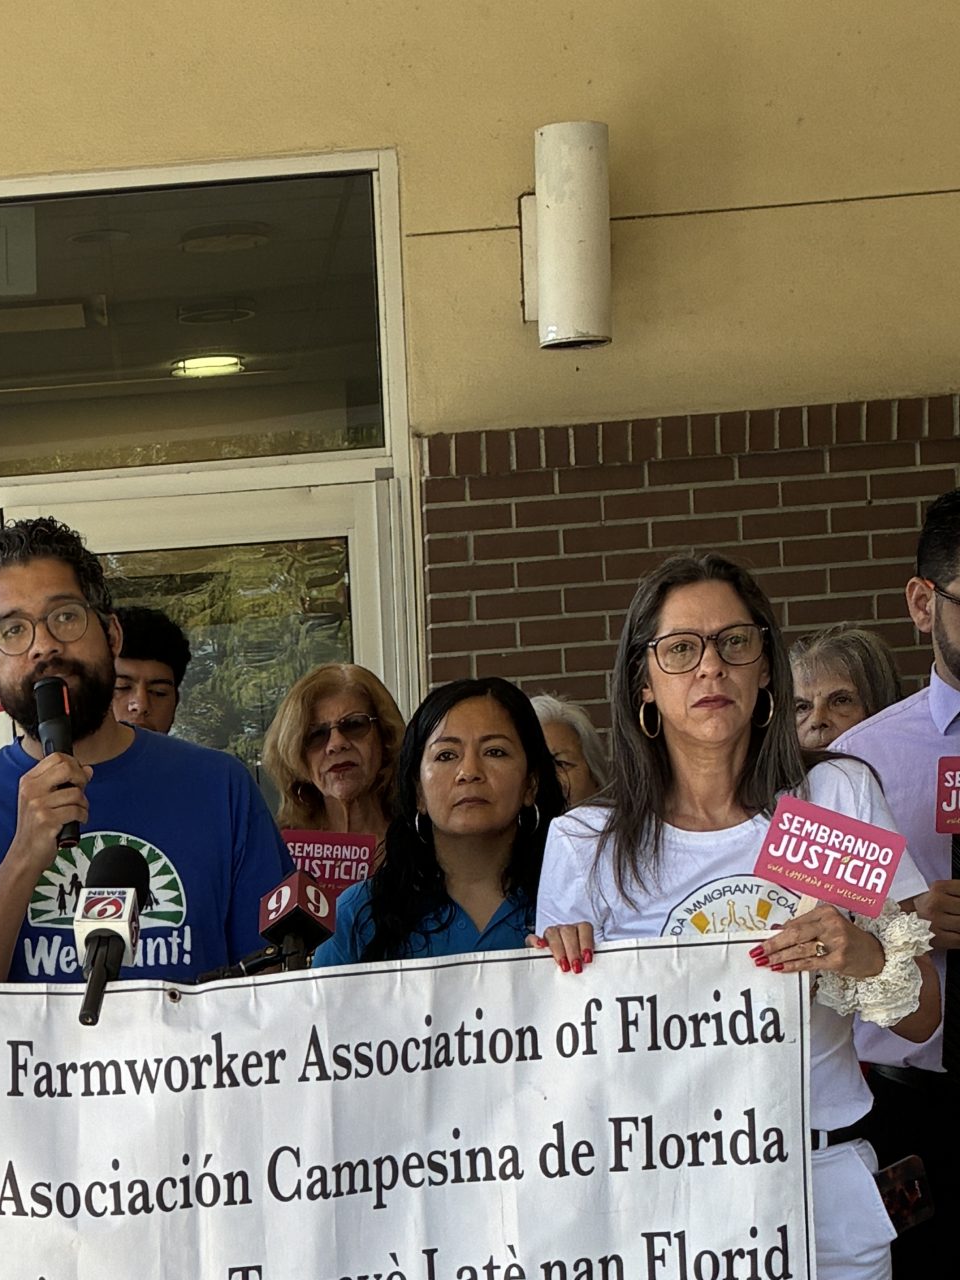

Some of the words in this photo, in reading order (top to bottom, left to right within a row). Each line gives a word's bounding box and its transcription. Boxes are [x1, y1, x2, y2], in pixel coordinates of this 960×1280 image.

[287, 842, 370, 860] SEMBRANDO
[779, 812, 894, 866] SEMBRANDO
[85, 897, 125, 919] 6
[87, 889, 128, 897] NEWS
[267, 885, 291, 920] 9
[306, 885, 329, 918] 9
[683, 883, 764, 915] IMMIGRANT
[6, 1031, 287, 1098] Farmworker
[297, 1008, 543, 1083] Association
[556, 998, 603, 1058] of
[615, 988, 786, 1056] Florida
[267, 1127, 525, 1210] Campesina
[539, 1121, 595, 1179] de
[608, 1107, 789, 1172] Florida
